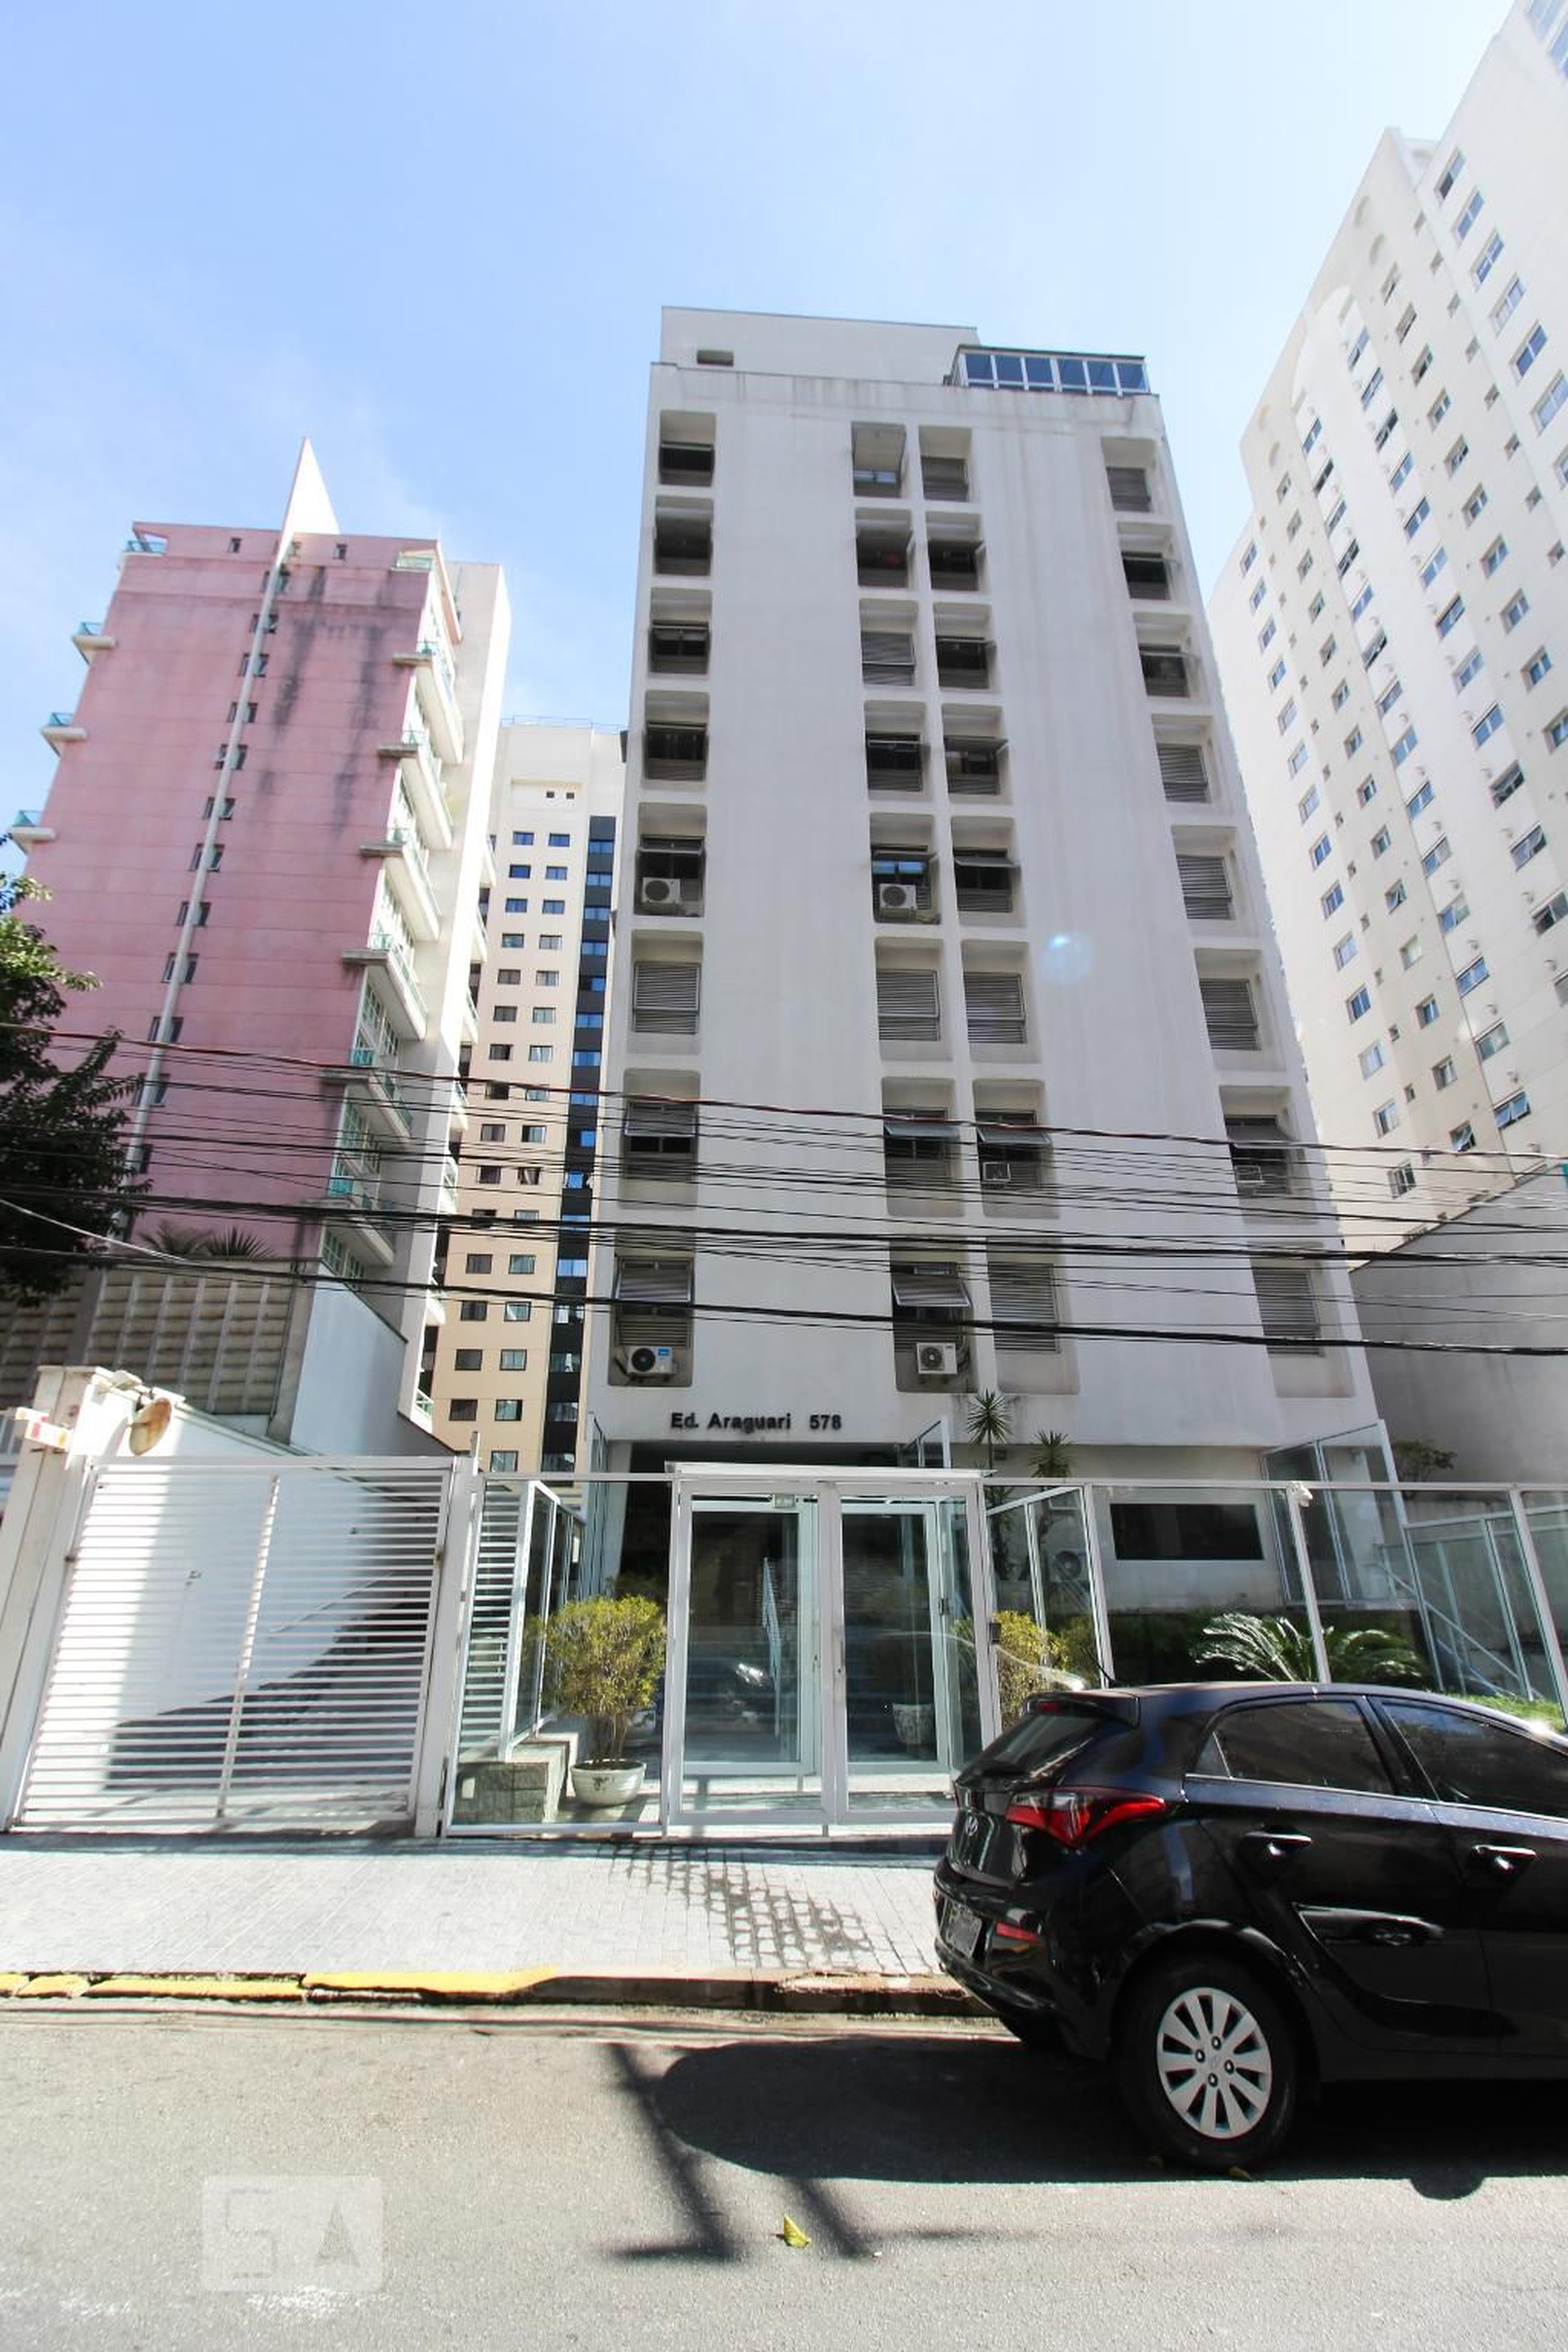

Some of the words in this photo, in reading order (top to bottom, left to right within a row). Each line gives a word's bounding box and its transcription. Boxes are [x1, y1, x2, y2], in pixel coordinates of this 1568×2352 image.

[670, 1412, 699, 1429] Ed.
[707, 1412, 791, 1434] Araguari
[809, 1414, 842, 1430] 578
